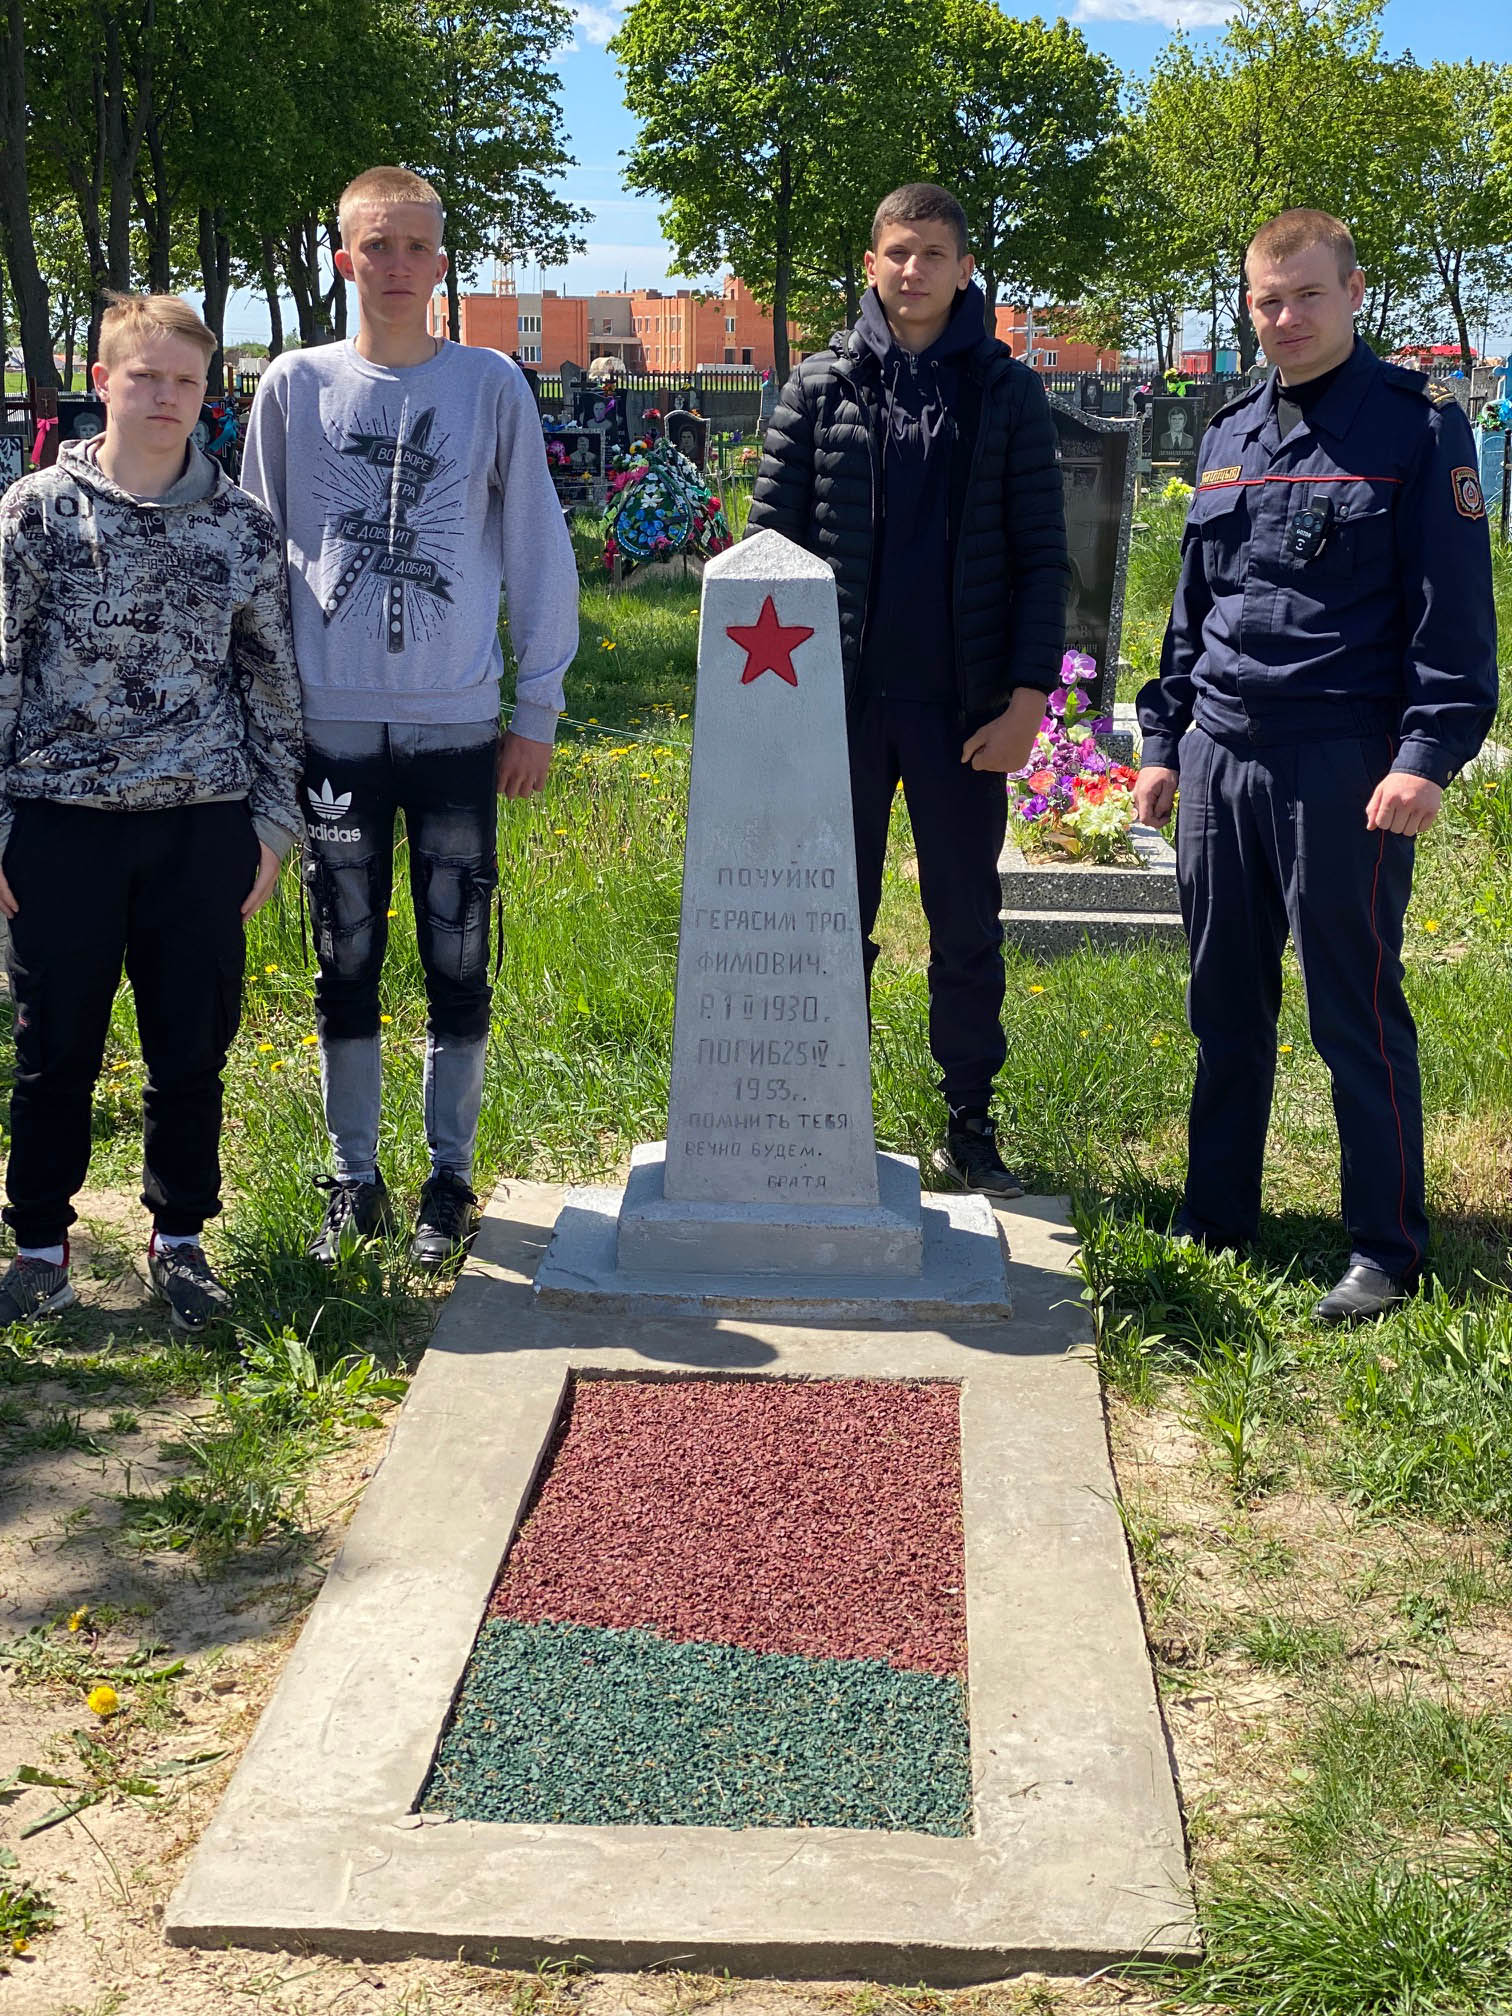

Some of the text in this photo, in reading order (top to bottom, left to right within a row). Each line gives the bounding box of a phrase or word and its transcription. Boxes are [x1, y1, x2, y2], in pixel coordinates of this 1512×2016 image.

[341, 520, 359, 535] НЕ
[393, 558, 433, 578] ДОБРА
[307, 822, 361, 843] adidas
[717, 860, 836, 889] ПОЧУЙКО
[695, 909, 797, 932] ГЕРАСИМ
[688, 1113, 849, 1130] ПОМНИТЬ ТЕБЯ
[685, 1141, 741, 1158] ВЕЧНО
